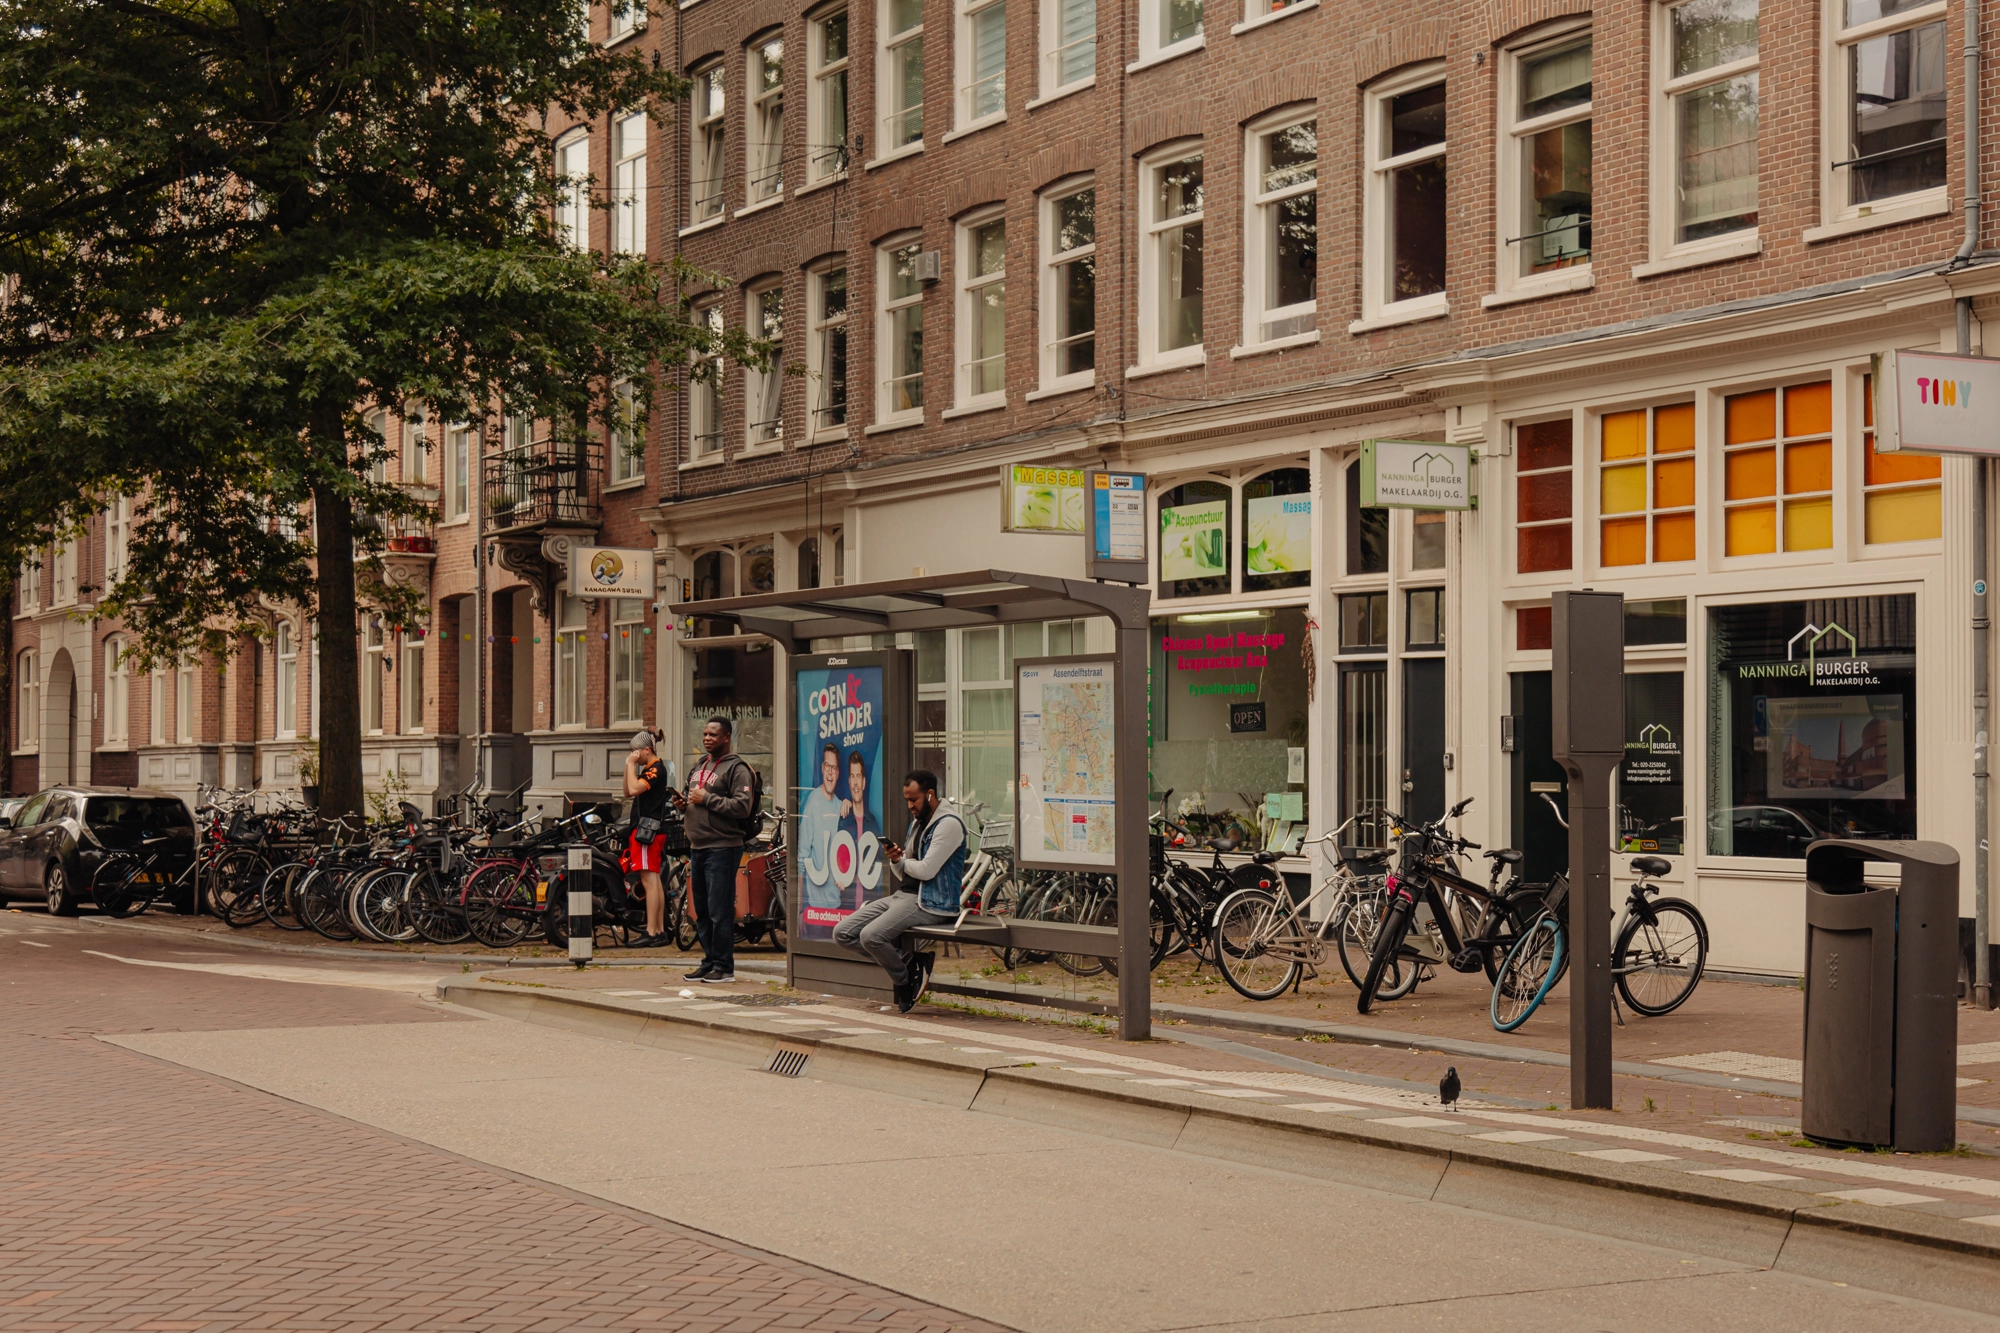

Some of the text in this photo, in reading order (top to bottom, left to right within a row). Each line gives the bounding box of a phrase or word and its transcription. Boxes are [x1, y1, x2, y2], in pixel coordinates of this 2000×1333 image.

[1916, 377, 1972, 409] TINY
[1381, 473, 1462, 484] NANNINGA BURGER
[1382, 487, 1462, 499] MAKELAARDIJ O.G.
[1175, 510, 1223, 528] Acupunctuur
[1162, 632, 1285, 652] Chinese Sport Massage
[827, 657, 848, 666] JCDecaux
[1177, 651, 1268, 673] Acupunctuur Ana
[1053, 667, 1103, 678] Assendelftstraat
[1740, 661, 1869, 678] NANNINGA BURGER
[1189, 681, 1256, 697] Fysiotherapie
[1816, 677, 1880, 686] MAKELAARDIJ O.G.
[809, 673, 863, 716] COEN &
[687, 706, 733, 721] ANAGAWA
[735, 706, 763, 721] SUSHI
[819, 701, 872, 739] SANDER
[1233, 711, 1261, 725] OPEN
[843, 732, 864, 747] show
[1653, 742, 1677, 750] BURGER
[807, 909, 819, 920] Elke
[820, 910, 840, 922] ochtend
